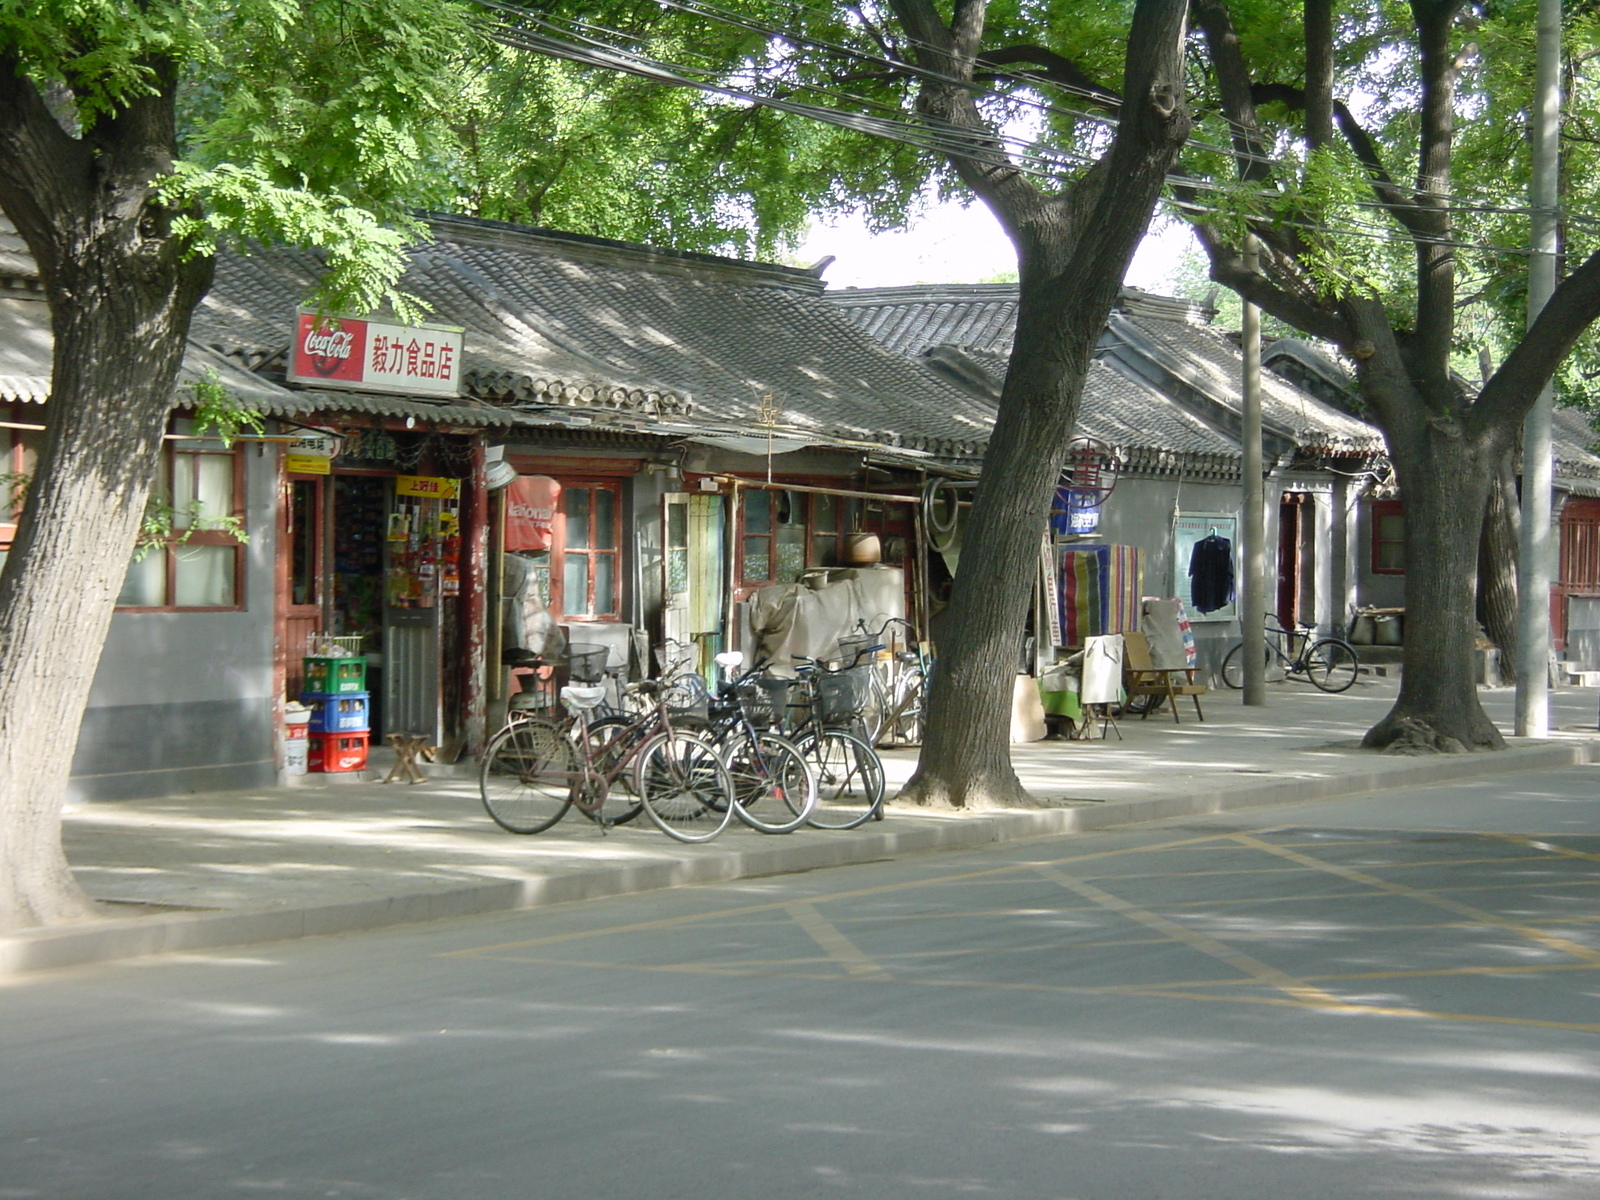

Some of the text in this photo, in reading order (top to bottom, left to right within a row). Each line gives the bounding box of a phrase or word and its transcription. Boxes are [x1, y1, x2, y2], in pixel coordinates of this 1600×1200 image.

[371, 333, 454, 381] 毅力食品店
[409, 480, 440, 493] 上好佳
